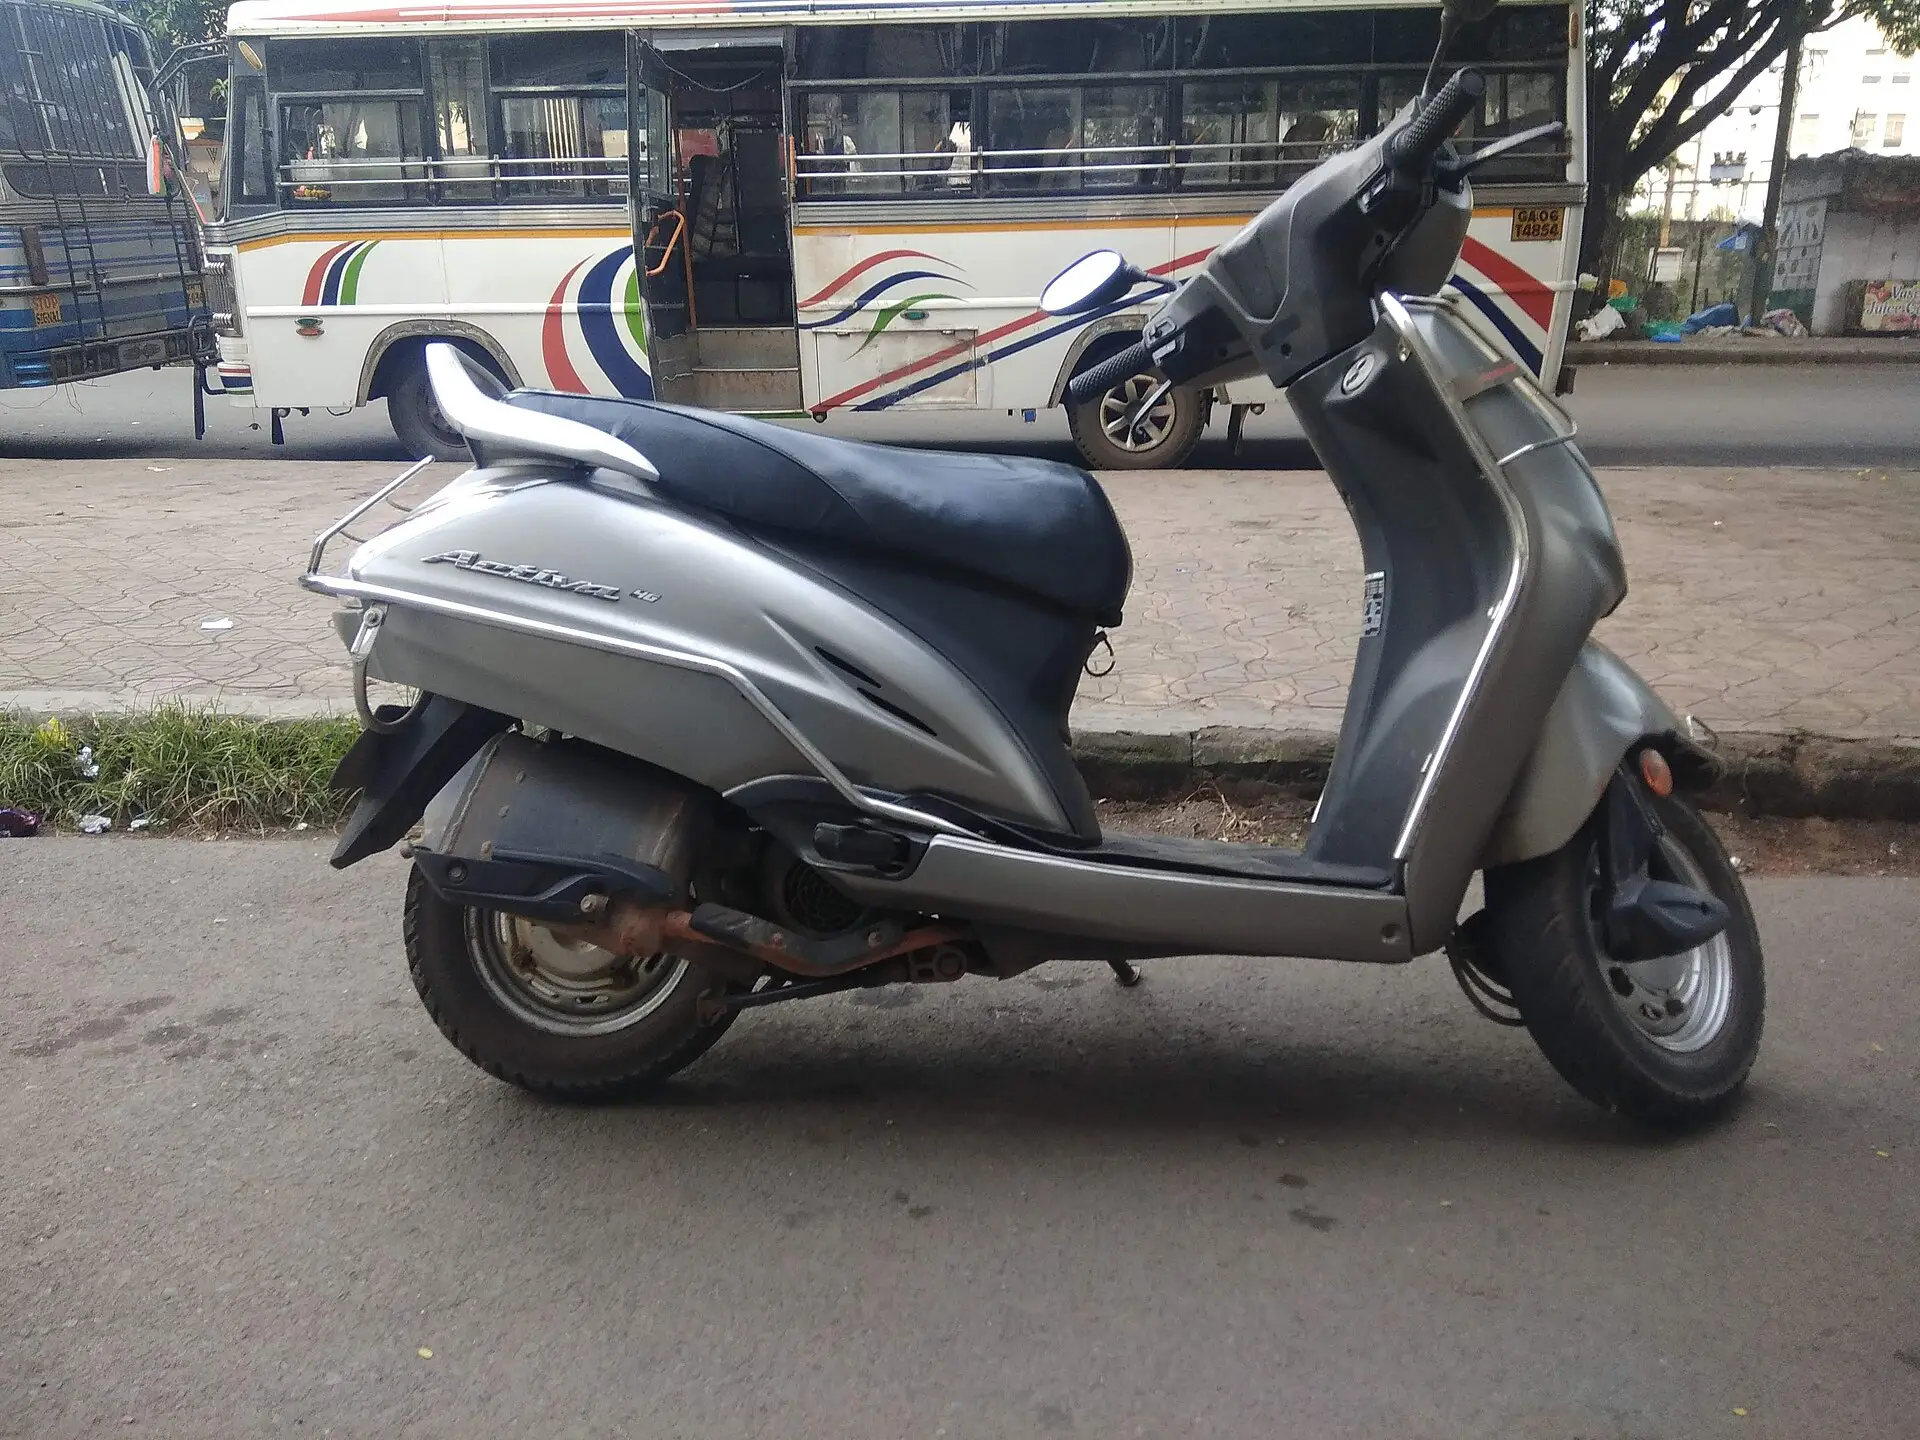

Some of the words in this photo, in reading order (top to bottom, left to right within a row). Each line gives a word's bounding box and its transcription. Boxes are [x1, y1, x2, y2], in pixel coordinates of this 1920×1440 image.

[34, 294, 59, 311] STOP
[36, 310, 61, 325] SIGNAL
[420, 549, 620, 601] Activa
[629, 588, 662, 603] 4G
